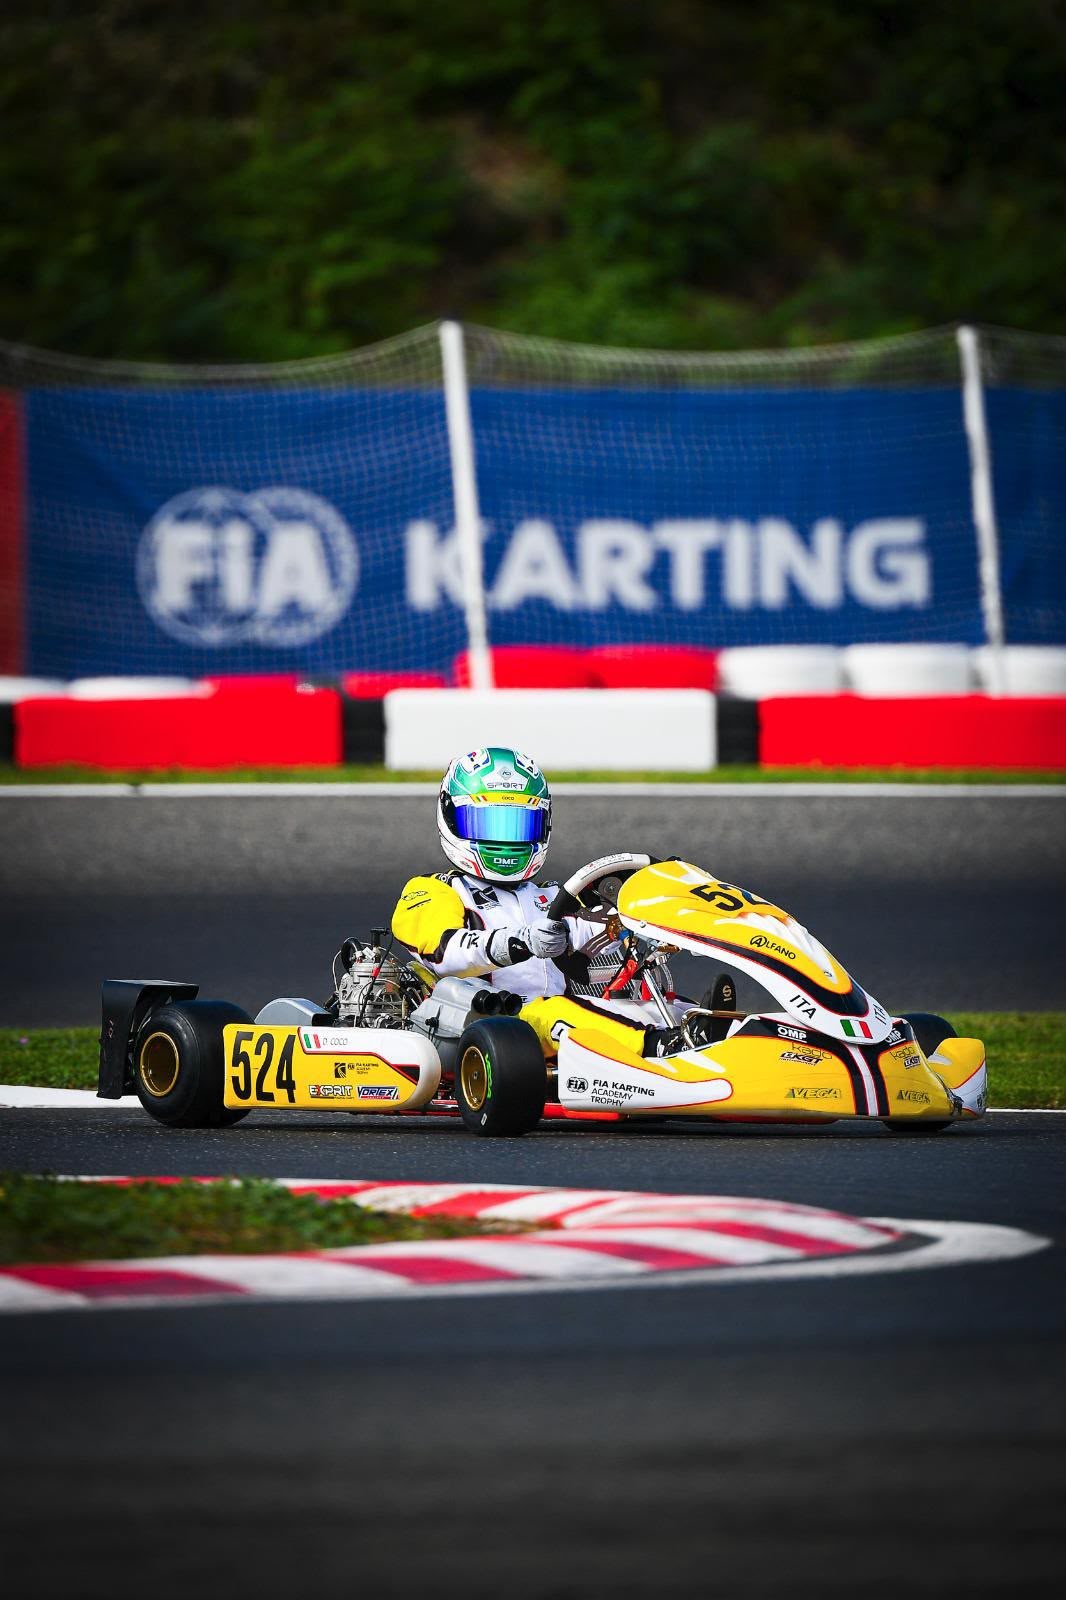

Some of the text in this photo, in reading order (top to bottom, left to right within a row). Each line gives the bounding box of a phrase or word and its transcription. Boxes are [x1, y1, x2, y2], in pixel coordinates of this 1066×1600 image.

[152, 517, 932, 616] FIA KARTING
[486, 782, 525, 790] SPORT
[750, 935, 796, 960] ALFANO
[789, 994, 817, 1019] ITA
[872, 1003, 888, 1026] ITA
[777, 1026, 807, 1041] OMP
[231, 1031, 297, 1104] 524
[591, 1088, 633, 1100] ACADEMY
[592, 1079, 656, 1097] FIA KARTING
[791, 1087, 842, 1099] VEGA
[590, 1095, 625, 1107] TROPHY
